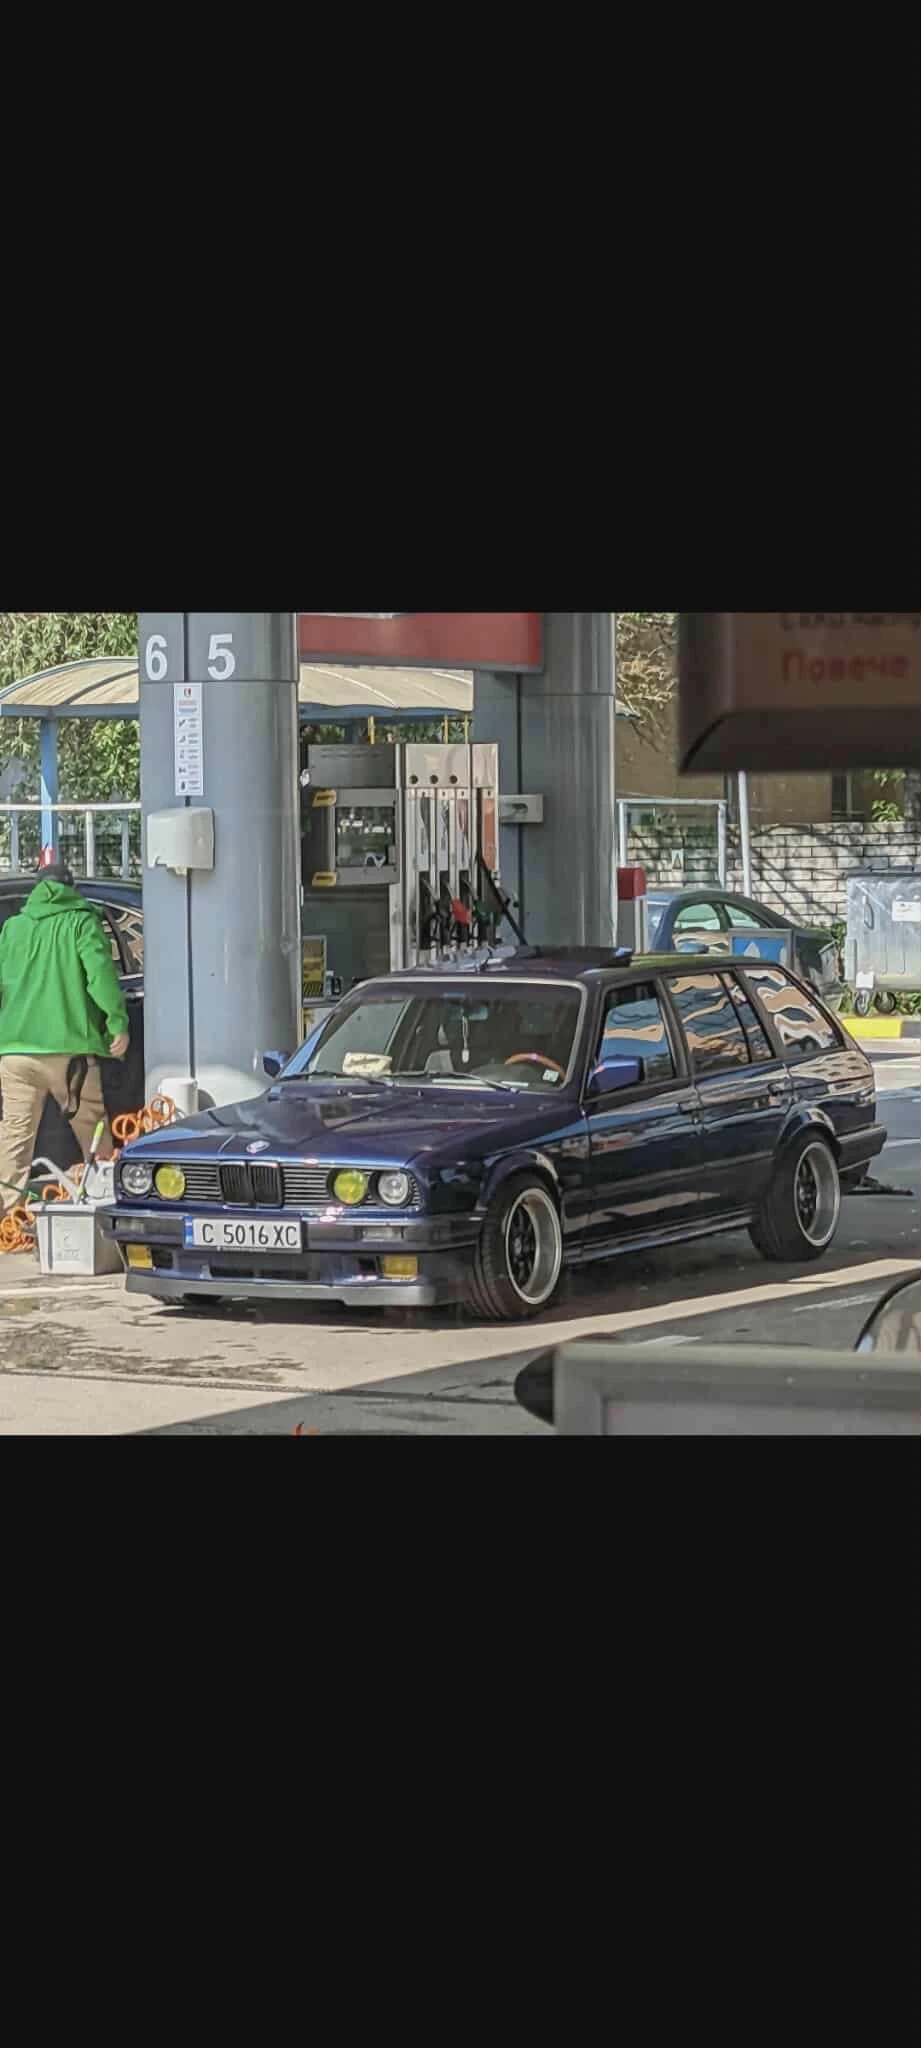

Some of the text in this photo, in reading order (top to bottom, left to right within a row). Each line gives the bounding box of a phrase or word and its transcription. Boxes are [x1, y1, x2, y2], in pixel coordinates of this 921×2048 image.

[145, 633, 236, 681] 6 5
[202, 1223, 297, 1246] C 5016 XC
